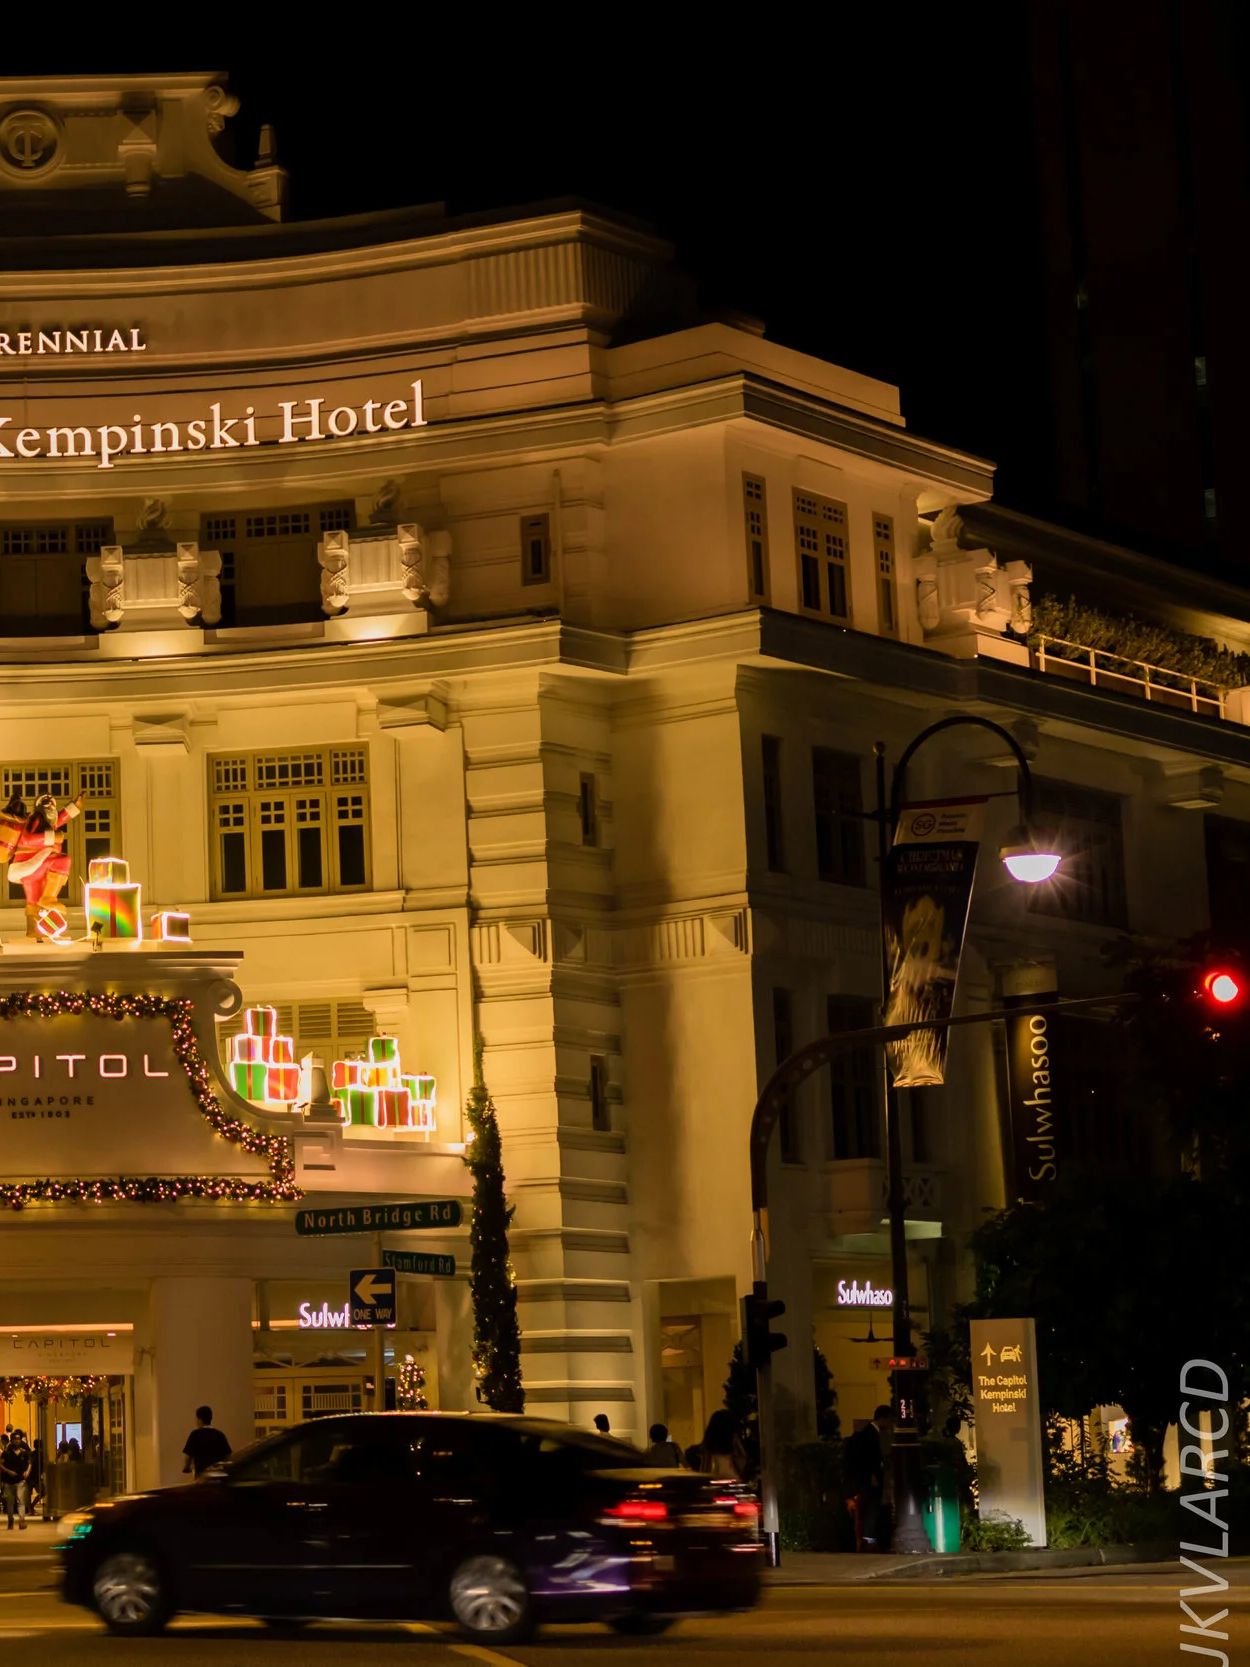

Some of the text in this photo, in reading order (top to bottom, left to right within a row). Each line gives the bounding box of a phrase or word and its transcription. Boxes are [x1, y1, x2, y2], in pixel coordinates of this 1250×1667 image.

[278, 379, 428, 444] Hotel
[1022, 1014, 1057, 1181] Sulwhasoo
[304, 1204, 451, 1229] North Bridge Rd
[384, 1254, 451, 1273] Stamford Rd
[837, 1279, 893, 1305] Sulwhaso
[353, 1307, 393, 1321] ONE WAY
[13, 1338, 111, 1349] CAPITOL
[978, 1374, 1028, 1387] The Capitol
[980, 1388, 1027, 1401] Kempinski
[992, 1402, 1017, 1413] Hotel
